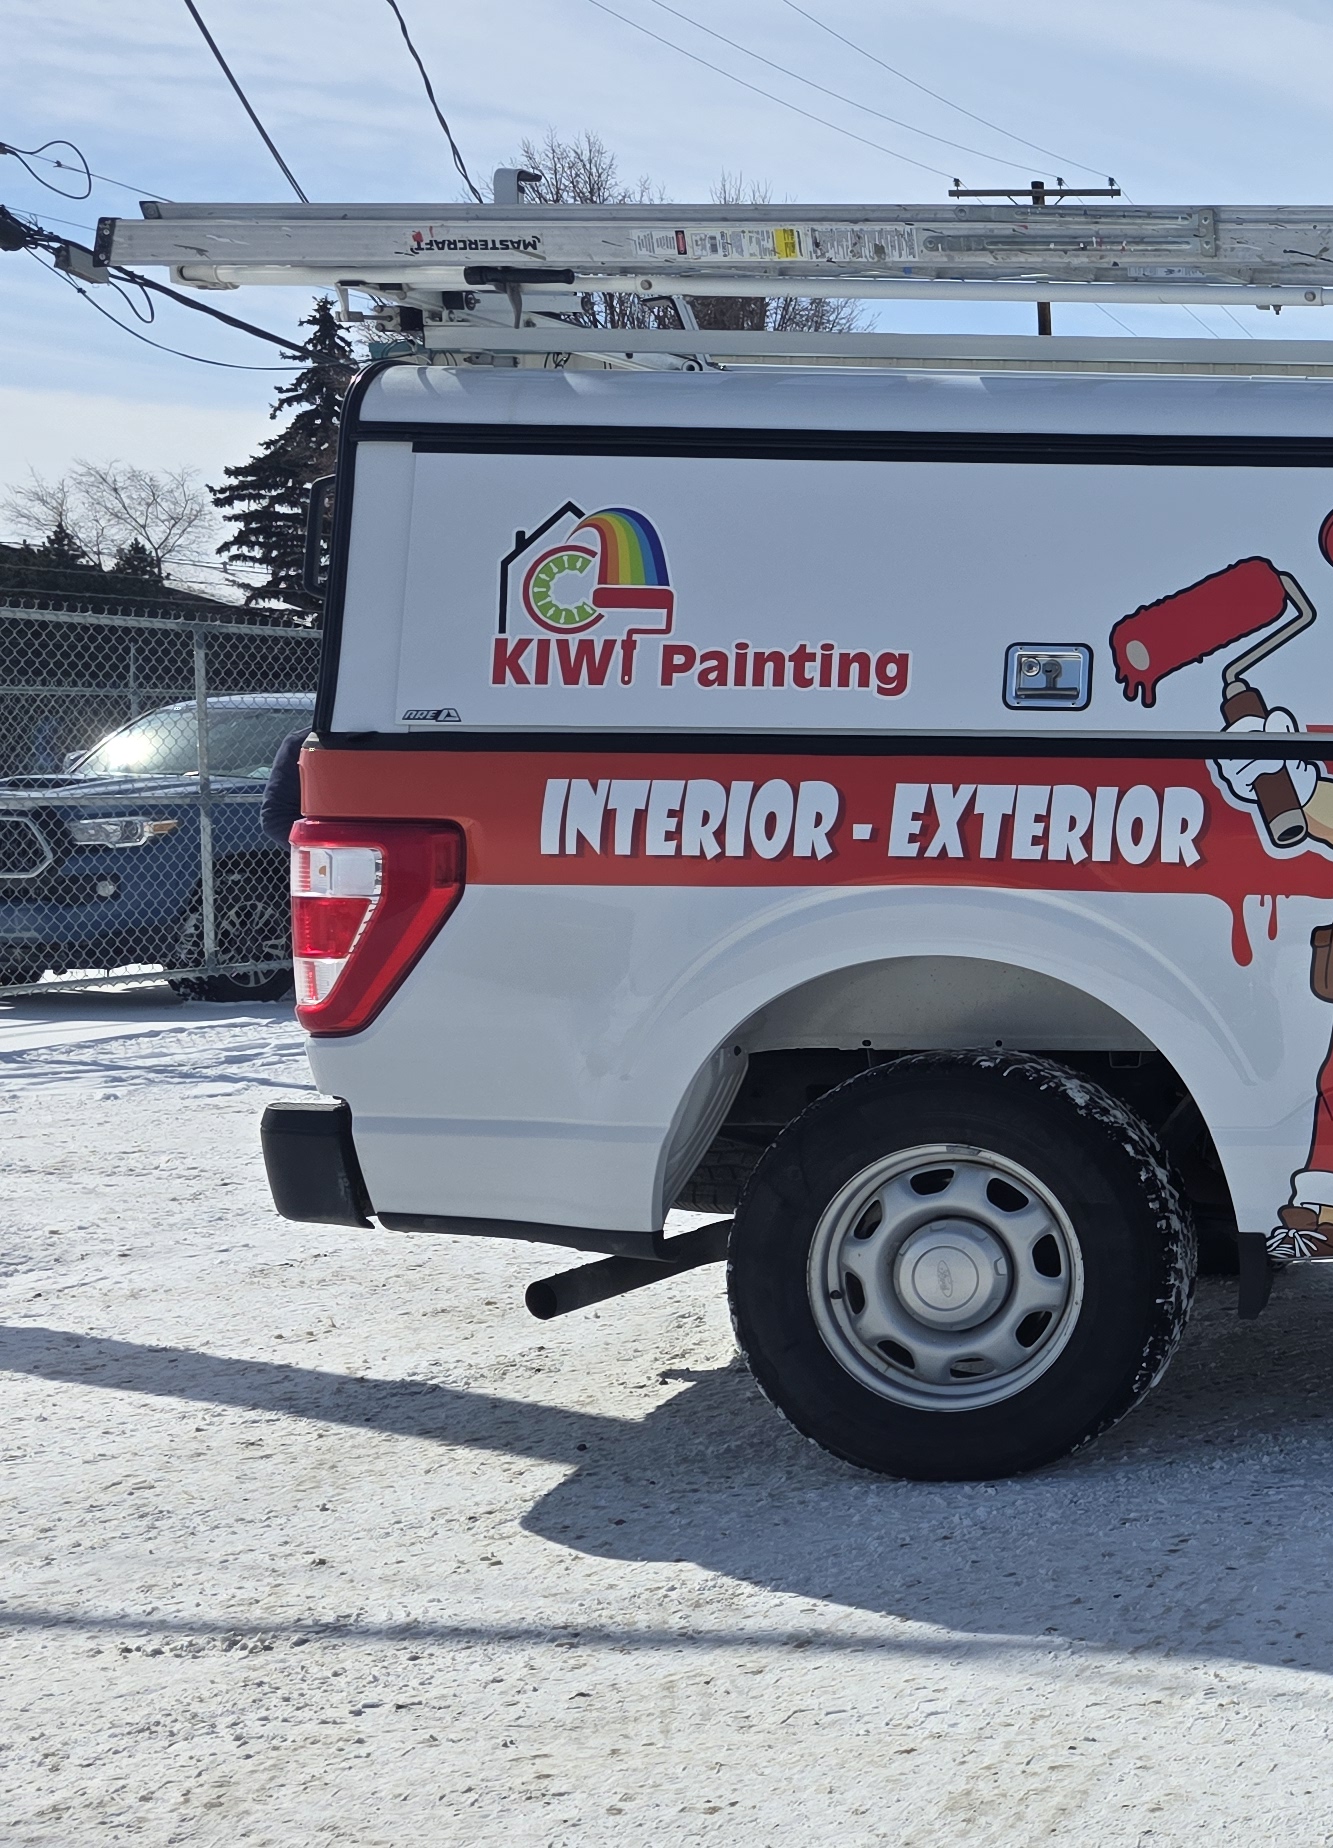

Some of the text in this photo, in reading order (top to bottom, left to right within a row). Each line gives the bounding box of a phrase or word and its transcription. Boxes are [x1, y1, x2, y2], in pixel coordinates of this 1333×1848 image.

[414, 238, 538, 251] MASTERCRAFT
[660, 641, 910, 697] Painting
[540, 778, 1205, 868] INTERIOR - EXTERIOR
